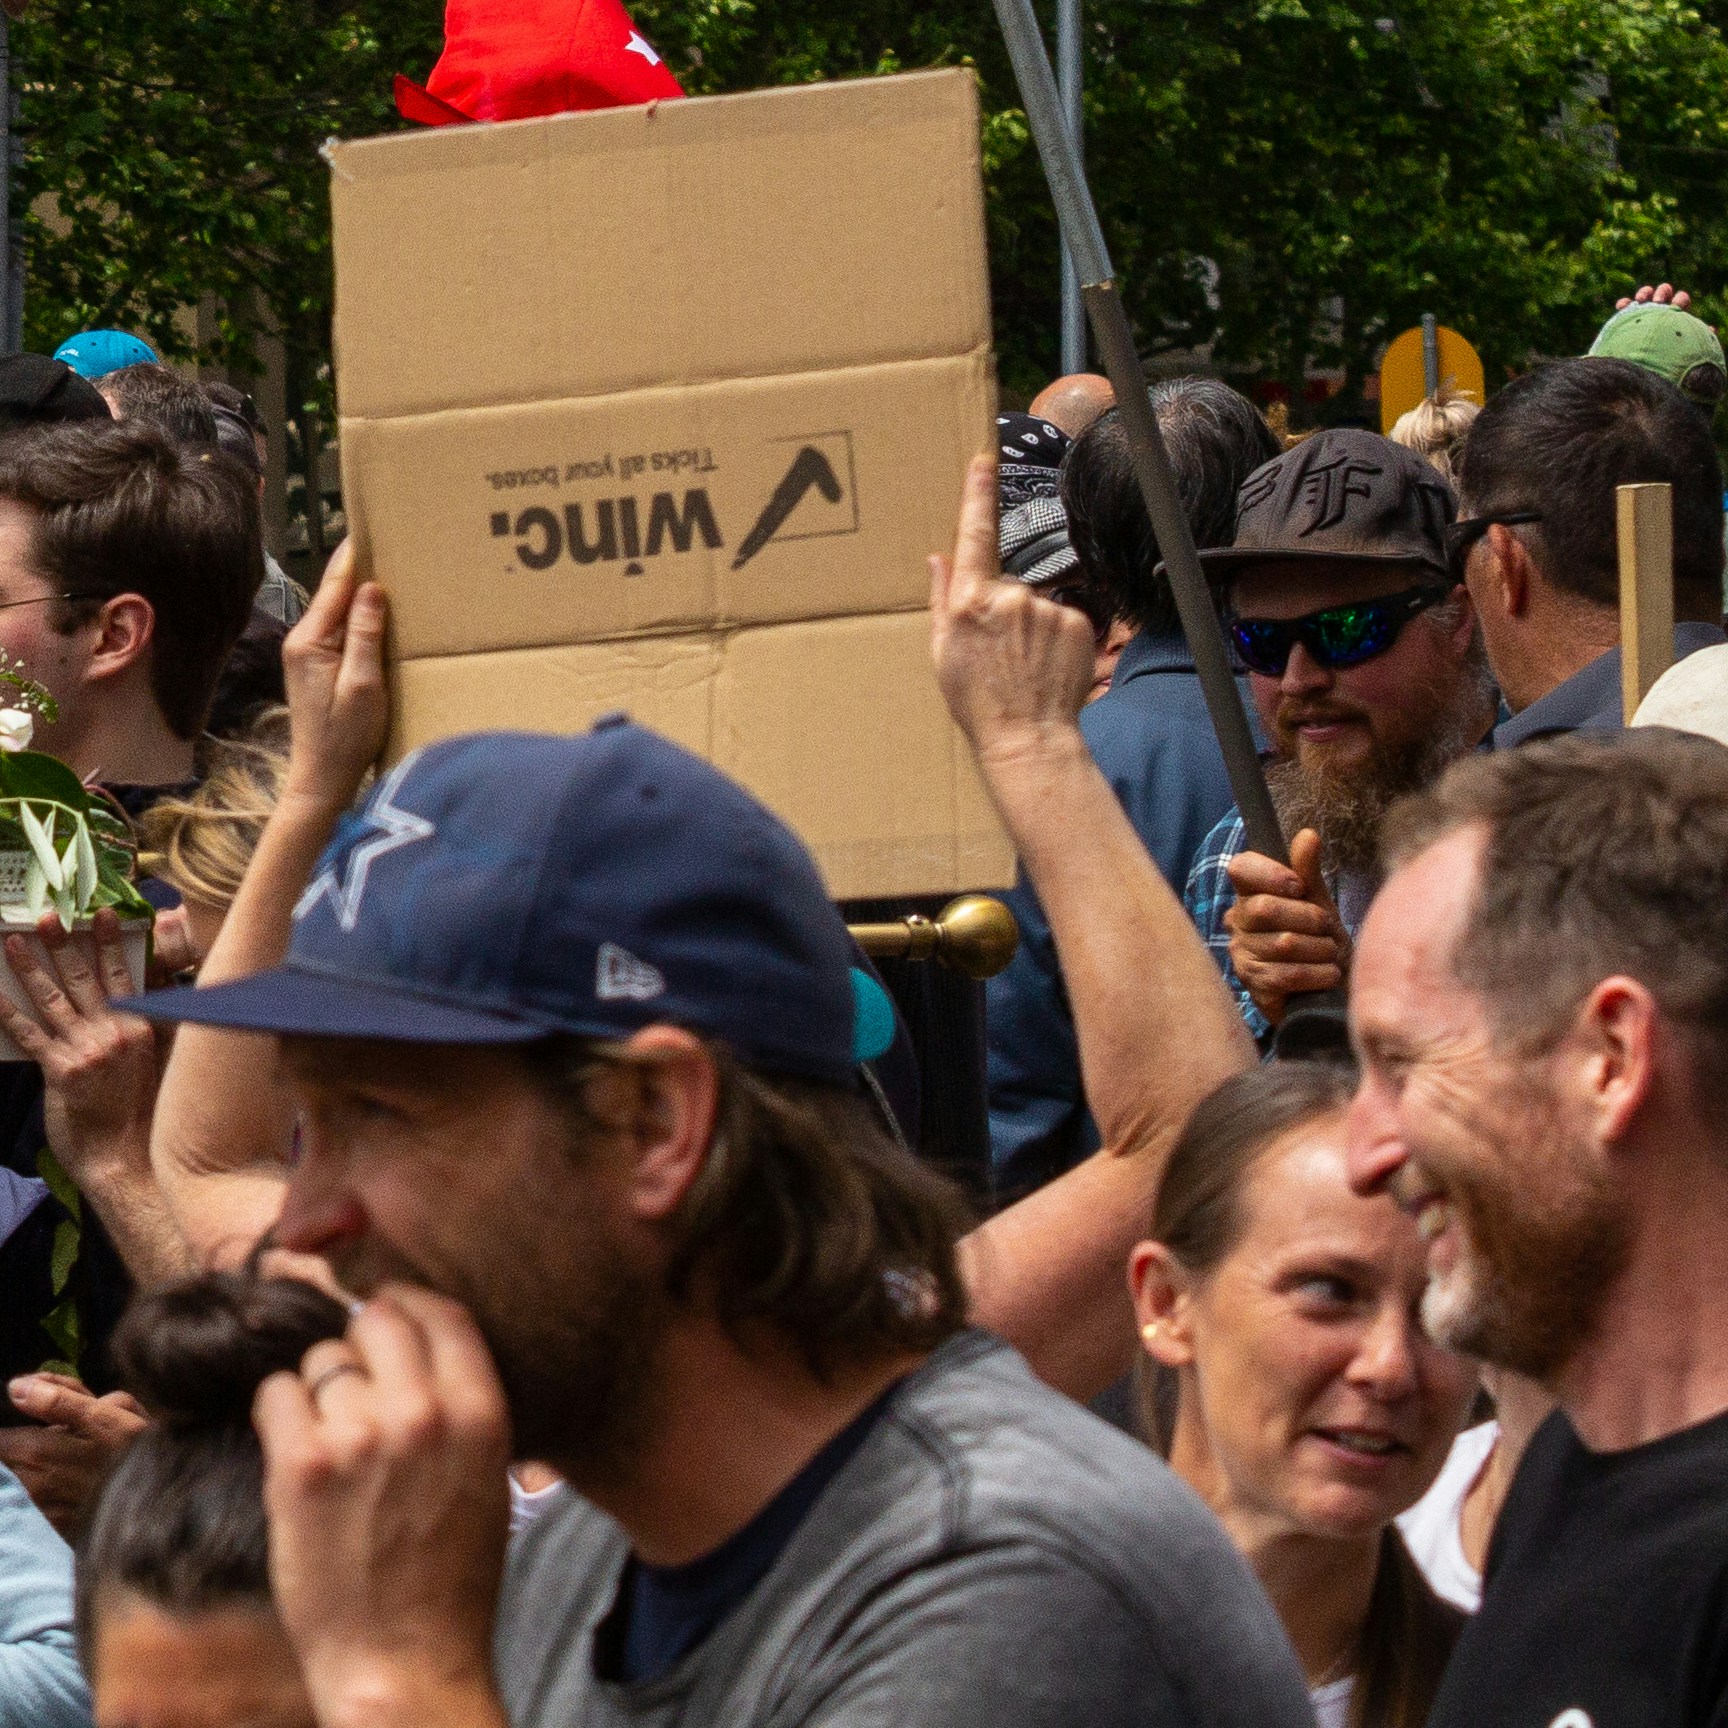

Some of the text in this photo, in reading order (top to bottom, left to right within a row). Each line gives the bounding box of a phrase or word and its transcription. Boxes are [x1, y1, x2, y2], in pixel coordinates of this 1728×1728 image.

[486, 447, 719, 491] Ticks all your boxes.
[489, 487, 725, 577] winc.
